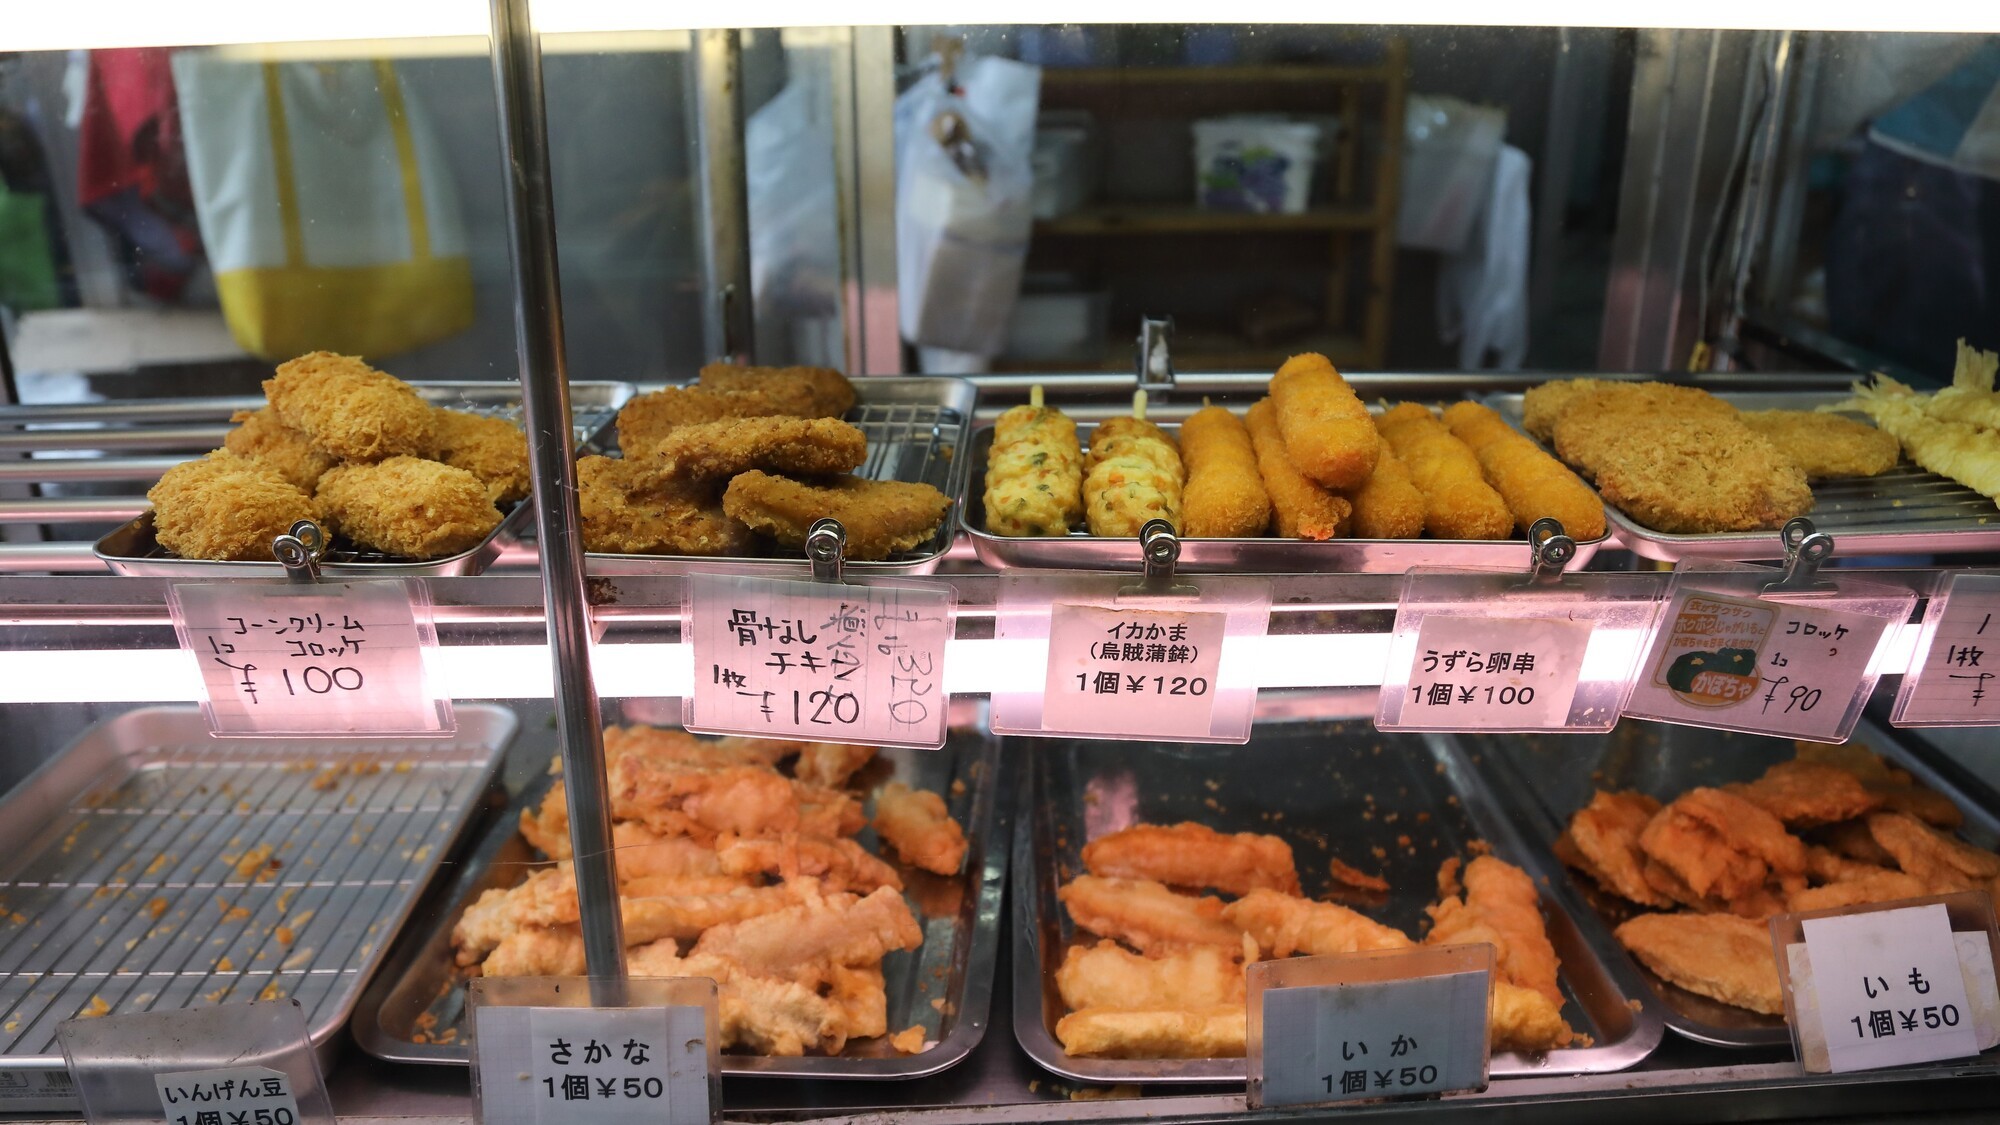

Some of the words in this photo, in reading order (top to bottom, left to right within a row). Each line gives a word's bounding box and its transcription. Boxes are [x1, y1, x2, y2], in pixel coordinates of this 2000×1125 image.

[227, 613, 365, 634] コーンクリーム
[728, 609, 817, 646] 骨なし
[1107, 622, 1188, 641] イカかま
[1786, 621, 1849, 640] コロッケ
[286, 636, 366, 657] コロッケ
[1947, 645, 1984, 667] 1枚
[1422, 650, 1535, 675] うずら卵串
[714, 665, 747, 688] 1枚
[1076, 671, 1208, 695] 1個¥120
[1692, 674, 1752, 699] かぼちゃ
[1412, 682, 1535, 706] 1個¥100
[1863, 967, 1930, 999] いも
[1851, 1004, 1960, 1038] 1個¥50
[550, 1038, 650, 1065] さかな
[1342, 1034, 1418, 1061] いか
[165, 1077, 287, 1104] いんげん豆
[542, 1074, 663, 1100] 1個¥50
[1322, 1065, 1438, 1094] 1個¥50
